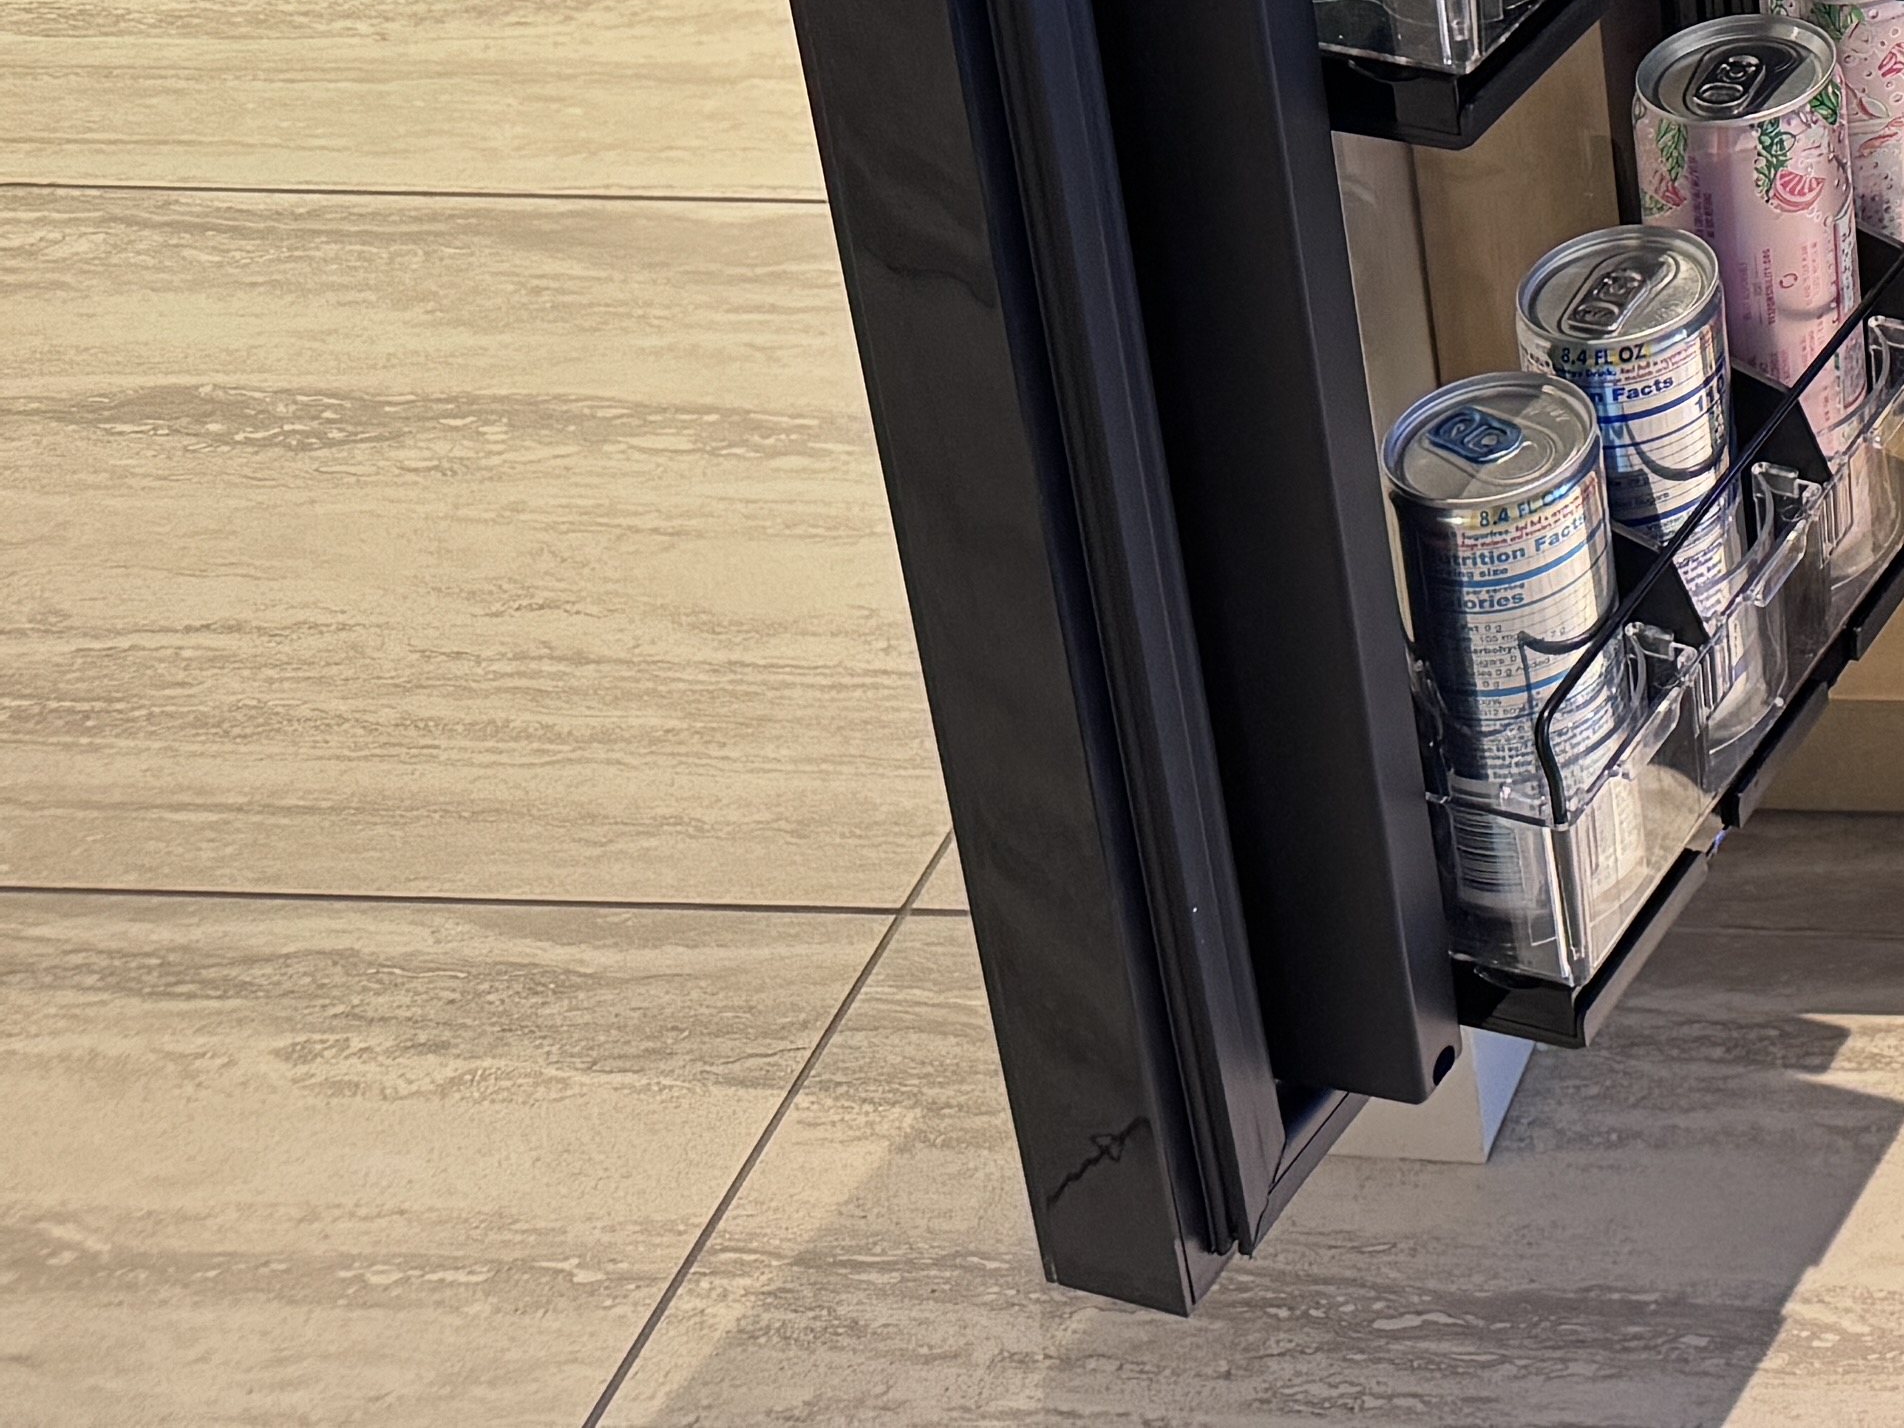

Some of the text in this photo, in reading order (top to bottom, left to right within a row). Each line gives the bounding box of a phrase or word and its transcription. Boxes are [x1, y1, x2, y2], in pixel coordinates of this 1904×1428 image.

[1561, 344, 1646, 366] 8.4 FL OZ
[1612, 376, 1674, 402] Facts
[1479, 508, 1510, 528] 8.4
[1517, 501, 1535, 517] FL
[1534, 515, 1586, 553] Facts
[1456, 592, 1525, 611] lories
